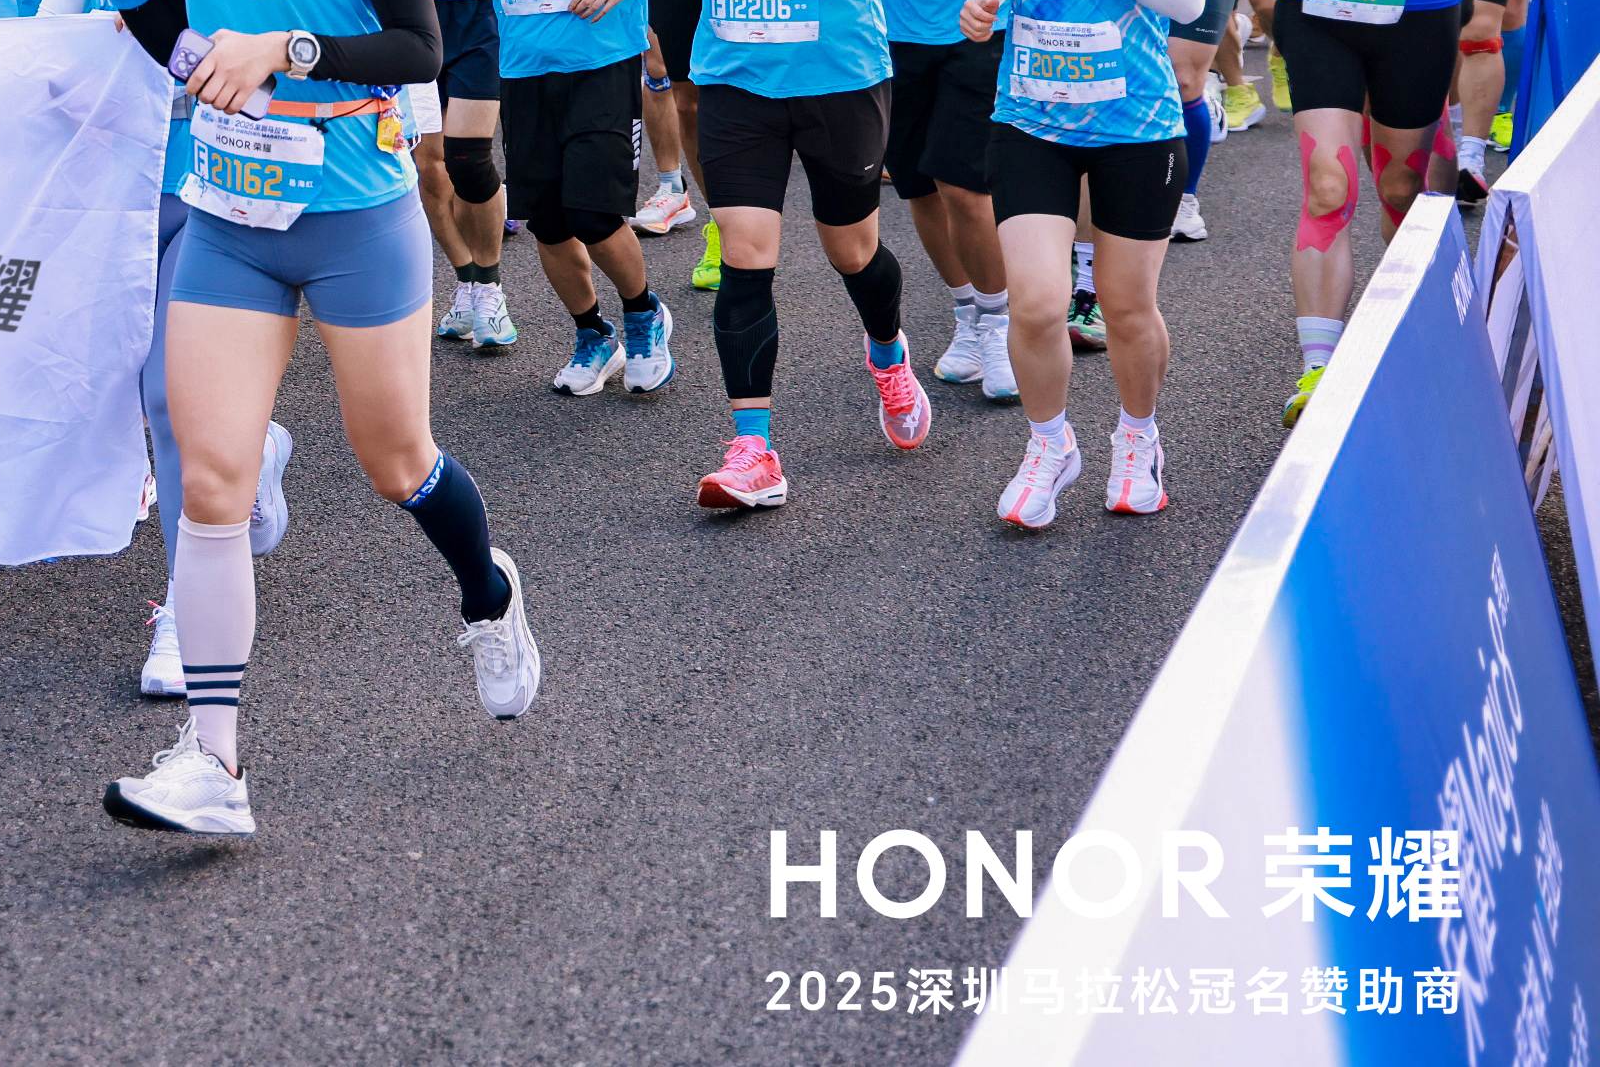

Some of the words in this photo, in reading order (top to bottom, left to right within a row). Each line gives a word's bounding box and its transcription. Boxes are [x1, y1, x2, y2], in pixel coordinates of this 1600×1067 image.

[1038, 38, 1065, 46] HONOR
[1031, 52, 1094, 79] 20755
[216, 134, 251, 149] HONOR
[253, 142, 272, 152] 荣耀
[262, 133, 293, 141] MARATHON
[212, 152, 283, 197] 21162
